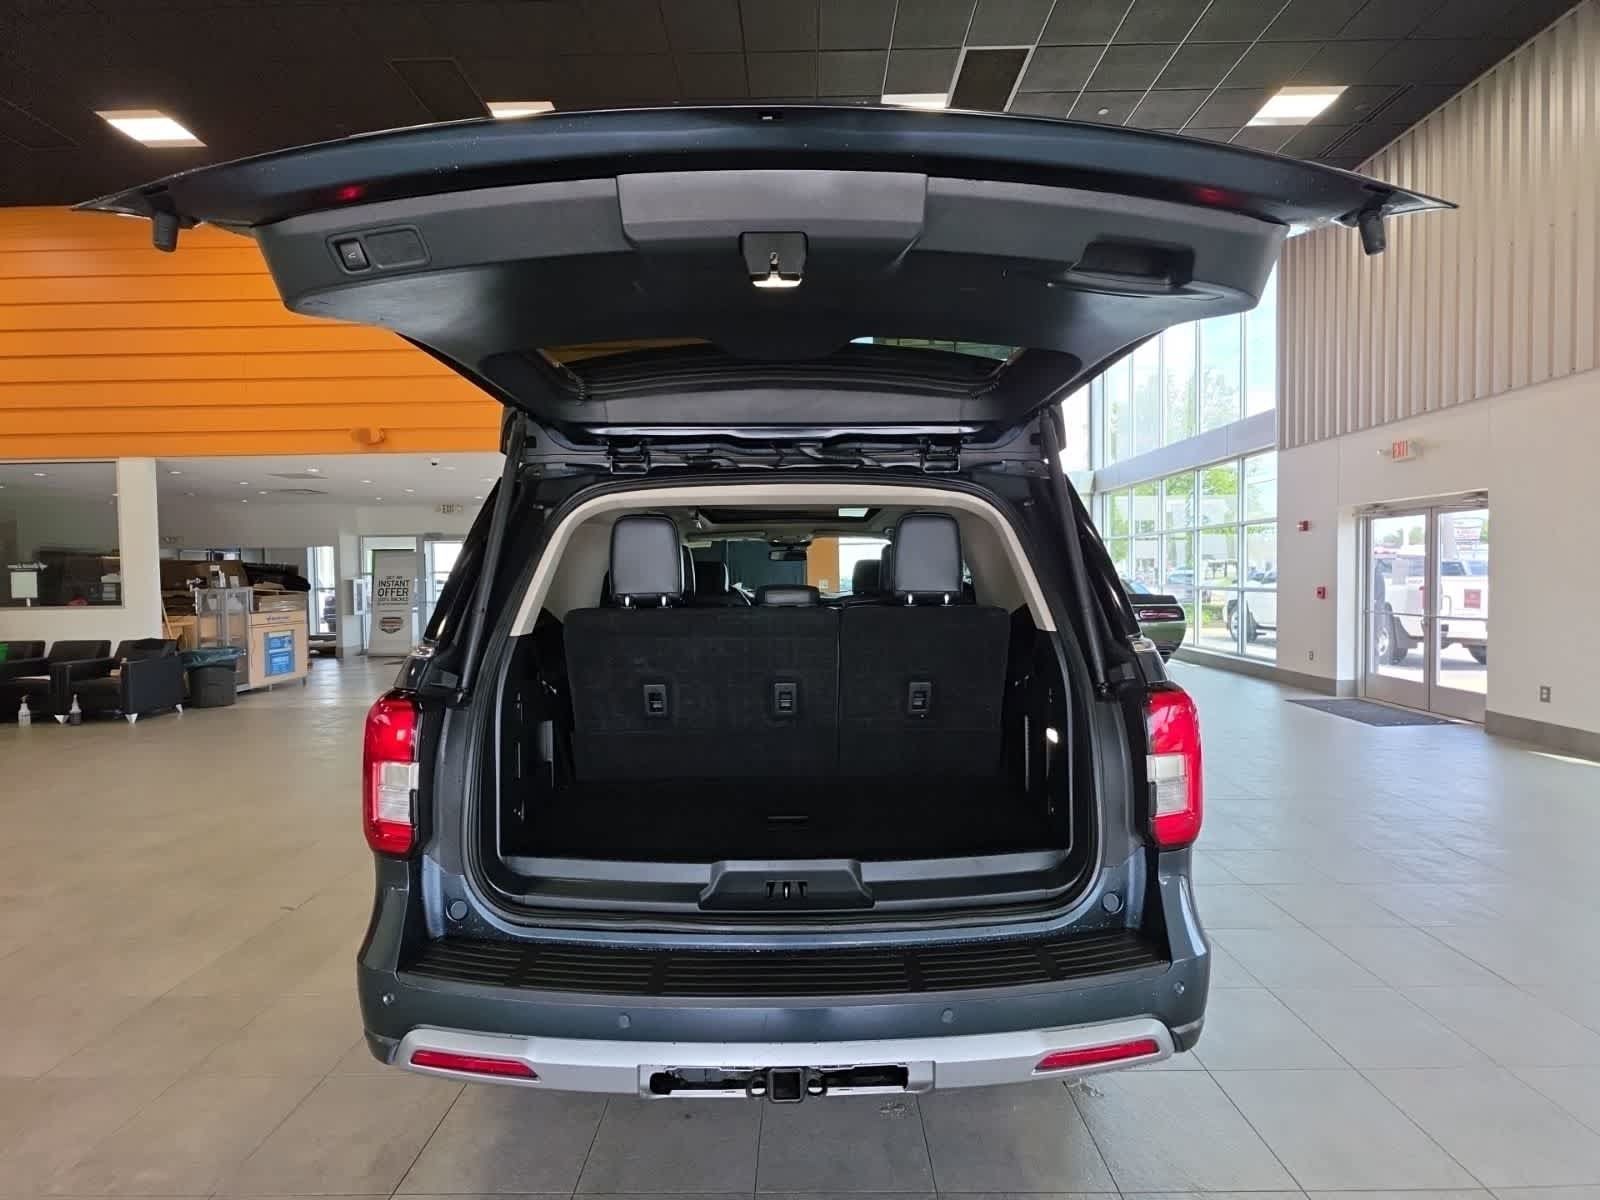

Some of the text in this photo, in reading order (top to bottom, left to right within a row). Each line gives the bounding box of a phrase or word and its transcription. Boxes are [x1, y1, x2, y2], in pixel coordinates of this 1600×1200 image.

[1392, 440, 1408, 458] EXIT
[378, 580, 409, 588] INSTANT
[377, 588, 408, 597] OFFER
